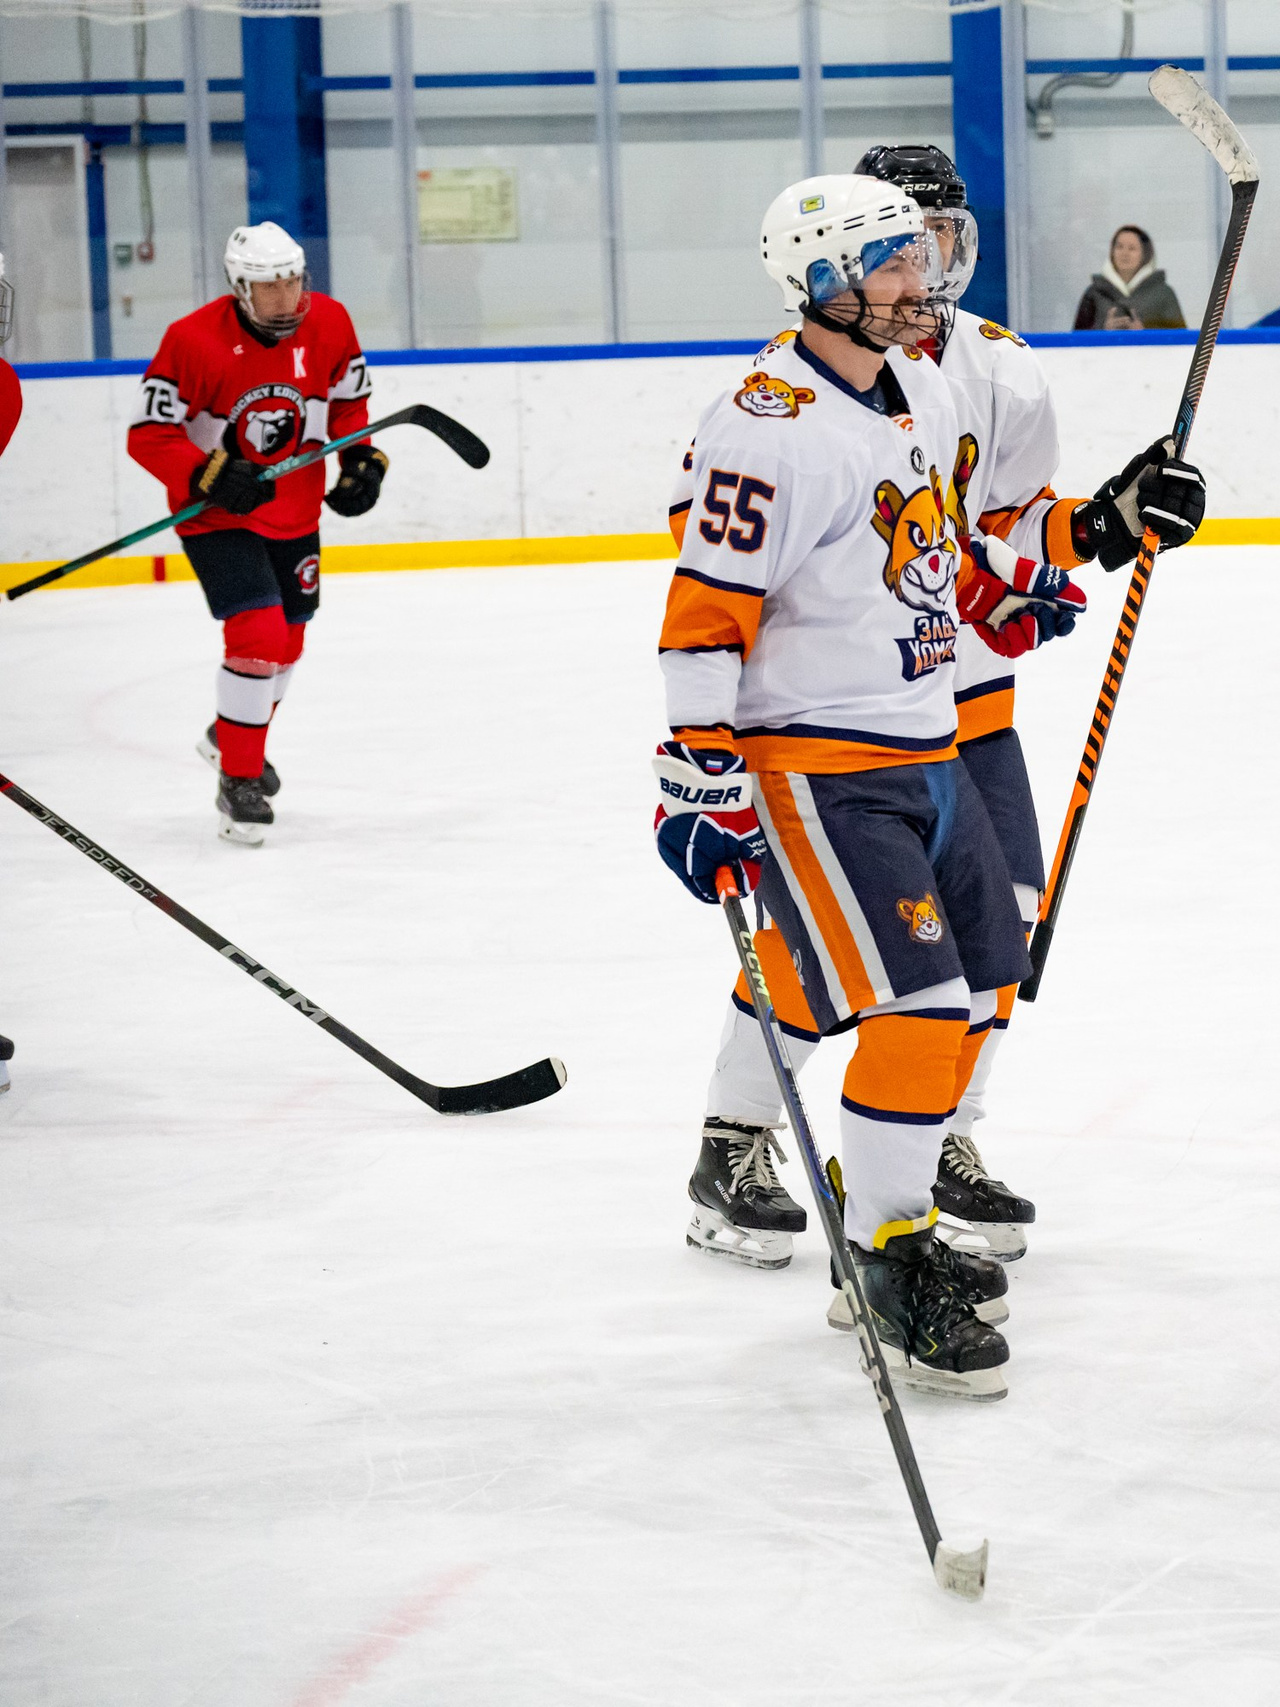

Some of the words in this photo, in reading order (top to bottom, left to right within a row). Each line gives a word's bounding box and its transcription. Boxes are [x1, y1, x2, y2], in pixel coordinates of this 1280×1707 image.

[901, 183, 941, 192] CCM
[143, 386, 175, 418] 72
[228, 386, 270, 424] HOCKEY
[699, 467, 776, 554] 55
[1077, 542, 1154, 790] WARRIOR
[660, 777, 742, 805] BAUER
[29, 806, 146, 894] JETSPEED
[220, 944, 327, 1025] CCM
[739, 930, 771, 996] CCM
[713, 1179, 732, 1205] BAUER
